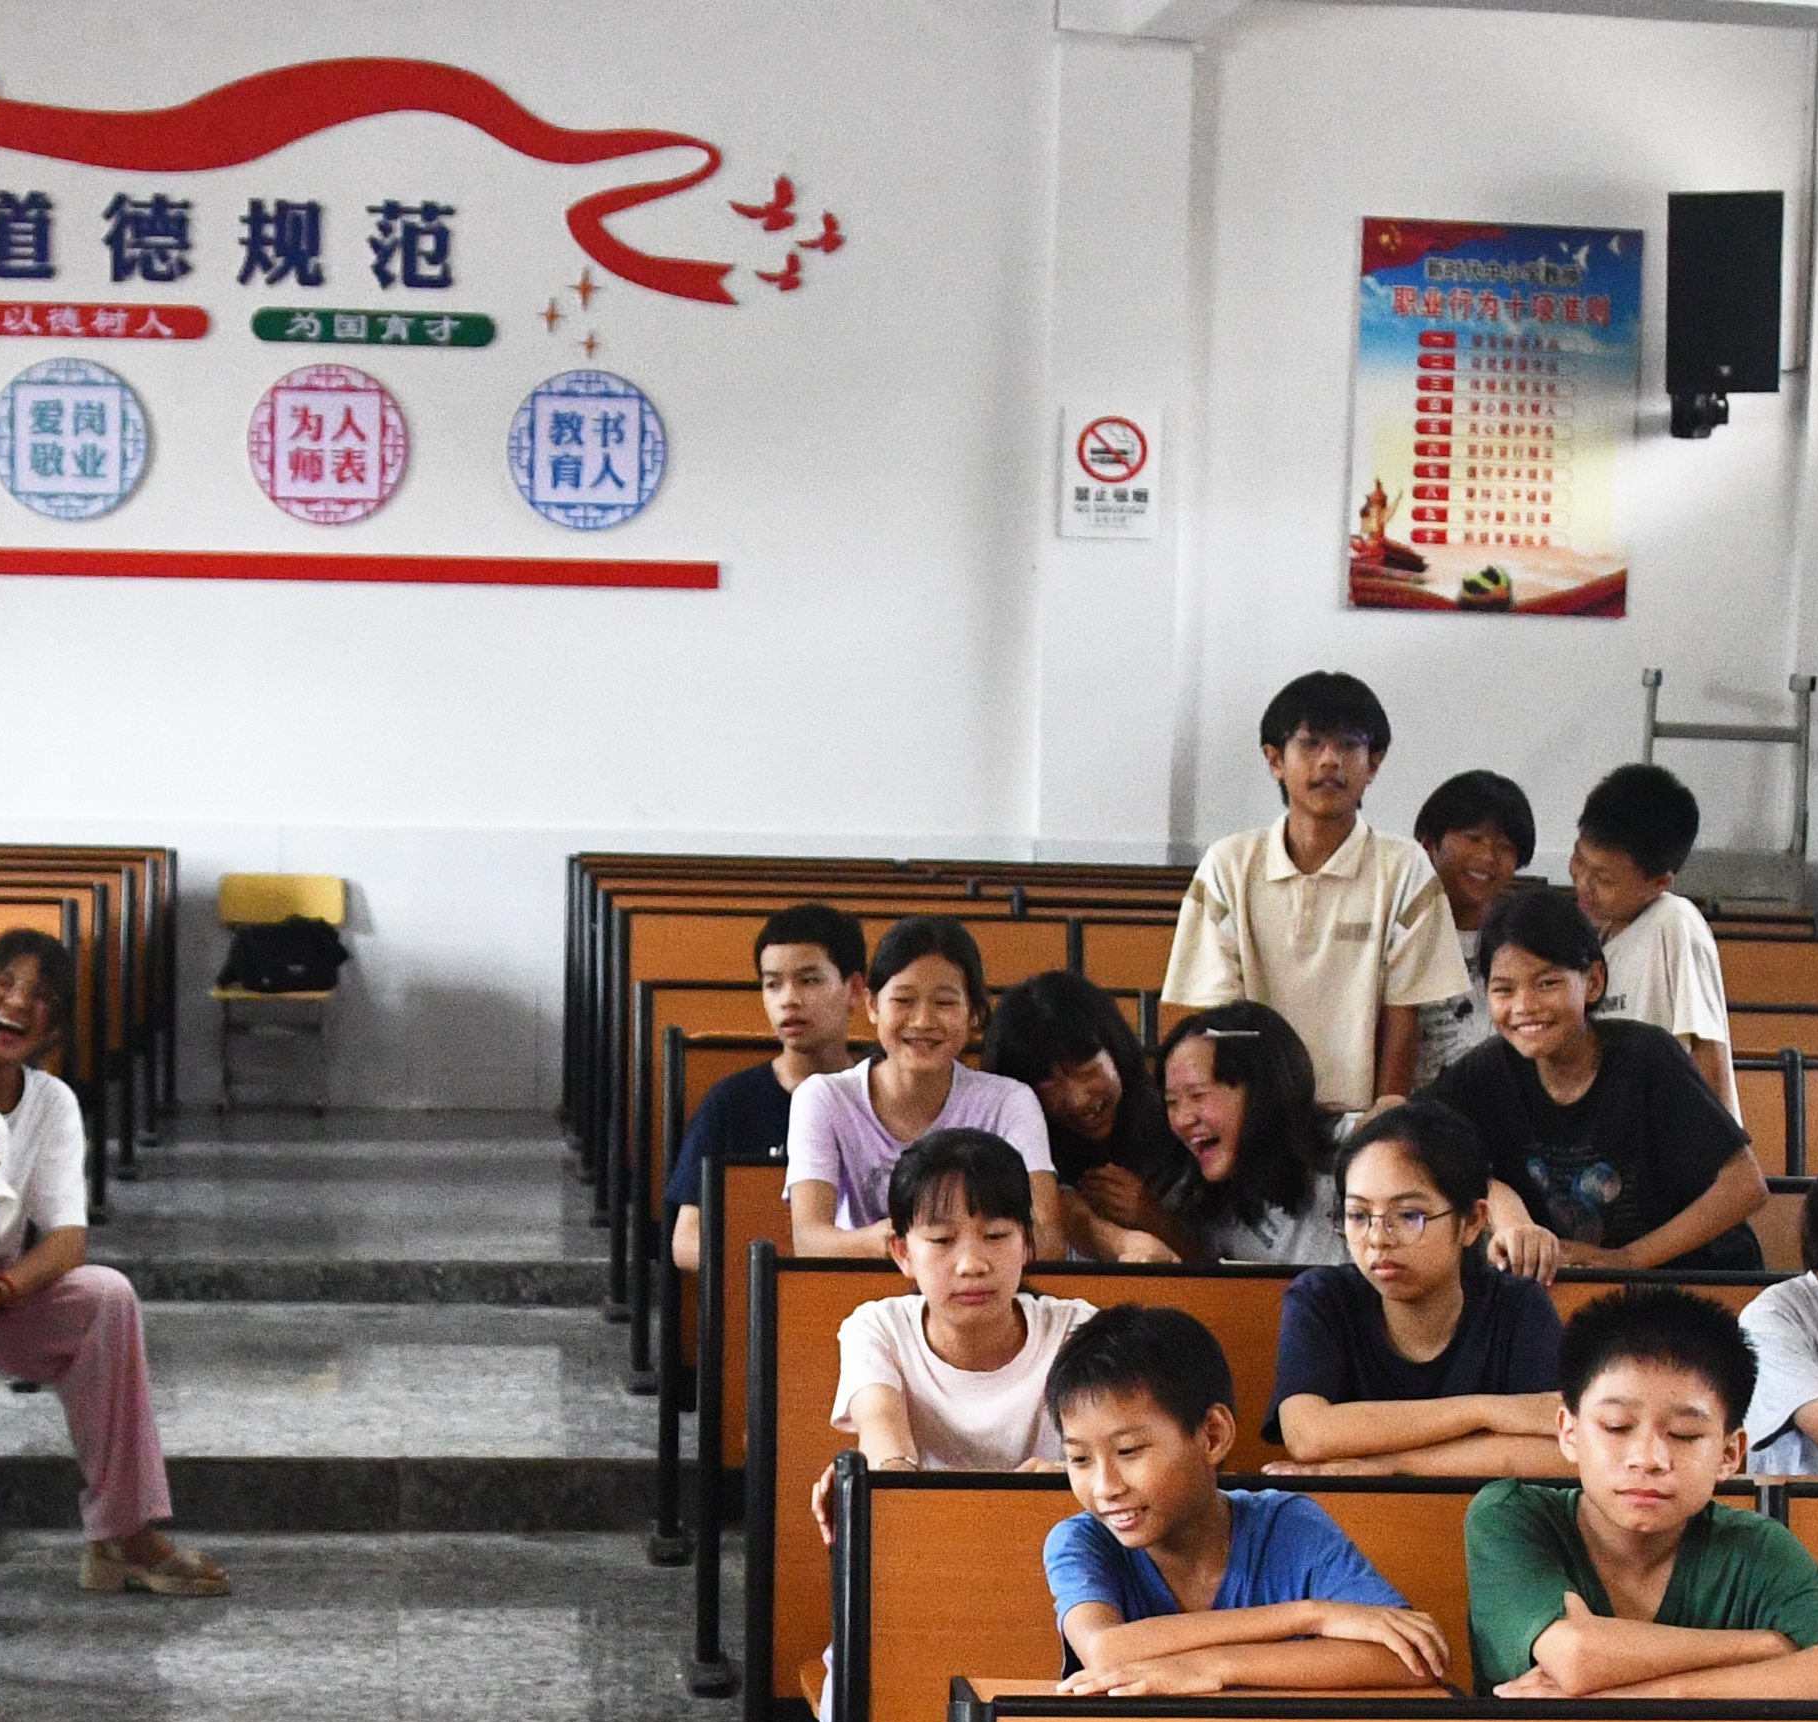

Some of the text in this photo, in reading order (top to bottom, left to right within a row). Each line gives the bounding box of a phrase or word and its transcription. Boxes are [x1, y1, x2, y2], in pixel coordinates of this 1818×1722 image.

[1, 306, 173, 338] 以德树人
[285, 312, 463, 345] 为国育才
